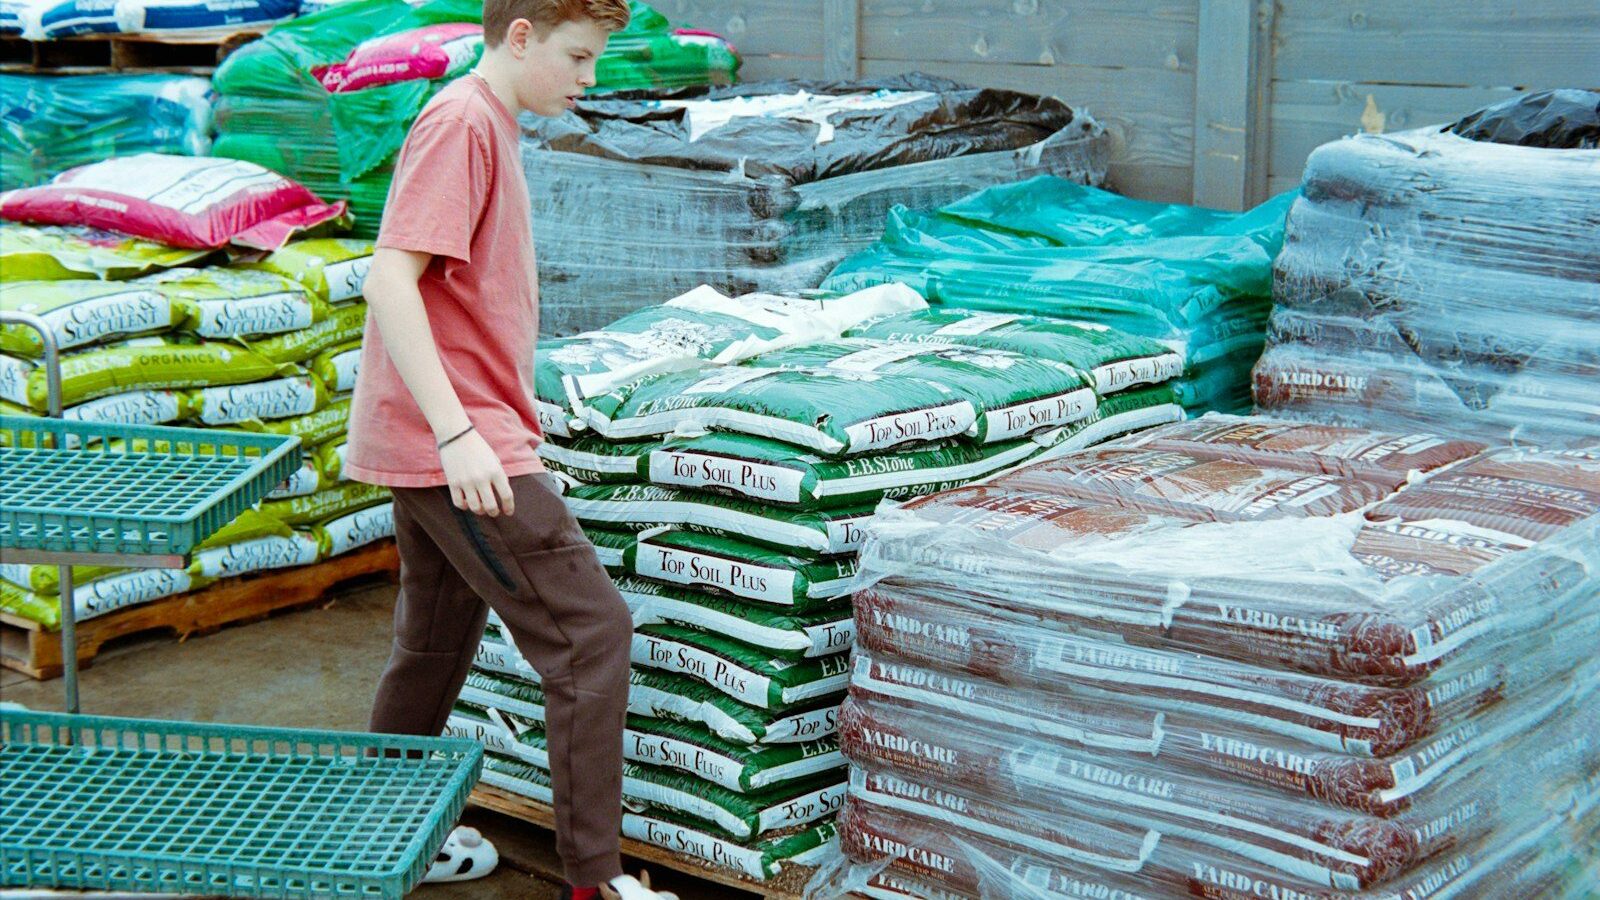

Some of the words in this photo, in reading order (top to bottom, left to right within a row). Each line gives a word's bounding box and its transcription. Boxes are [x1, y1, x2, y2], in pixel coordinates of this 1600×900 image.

[71, 303, 134, 324] CACTUS
[214, 313, 296, 333] SUCCULENT
[224, 302, 277, 320] CACTUS
[64, 309, 157, 342] SUCCULENT
[140, 352, 215, 366] ORGANICS
[1106, 366, 1128, 385] TOP
[1129, 363, 1151, 380] SOIL
[1152, 360, 1174, 378] PLUS
[1280, 371, 1367, 389] YARDCARE
[229, 386, 282, 406] CACTUS
[635, 394, 702, 417] E.B.Stone
[219, 400, 298, 420] SUCCULENT
[539, 412, 554, 428] US
[1003, 410, 1026, 431] TOP
[1028, 405, 1053, 426] SOIL
[1057, 399, 1082, 418] PLUS
[865, 422, 892, 443] TOP
[894, 418, 923, 439] SOIL
[925, 412, 956, 433] PLUS
[566, 466, 601, 482] PLUS
[672, 455, 697, 478] TOP
[702, 459, 735, 484] SOIL
[741, 465, 776, 492] PLUS
[847, 455, 914, 477] E.B.Stone
[610, 485, 680, 501] E.B.Stone
[883, 486, 908, 499] TOP
[227, 542, 286, 560] CACTUS
[658, 549, 684, 575] TOP
[690, 557, 724, 584] SOIL
[731, 565, 767, 592] PLUS
[84, 583, 174, 616] SUCCULENT
[93, 580, 155, 600] CACTUS
[873, 609, 970, 651] YARDCARE
[1219, 604, 1340, 641] YARDCARE
[823, 626, 850, 648] TOP
[476, 644, 504, 667] PLUS
[646, 640, 672, 663] TOP
[677, 648, 708, 677] SOIL
[714, 661, 747, 693] PLUS
[879, 662, 976, 699] YARDCARE
[476, 725, 505, 750] PLUS
[790, 716, 820, 737] TOP
[632, 734, 656, 758] TOP
[660, 740, 690, 768] SOIL
[694, 751, 725, 780] PLUS
[862, 727, 960, 765] YARDCARE
[1200, 731, 1319, 776] YARDCARE
[1069, 759, 1177, 798] YARDCARE
[782, 801, 814, 820] TOP
[820, 791, 846, 814] SOI
[875, 775, 970, 812] YARDCARE
[643, 820, 671, 846] TOP
[676, 830, 709, 861] SOIL
[713, 841, 744, 872] PLUS
[862, 832, 955, 874] YARDCARE
